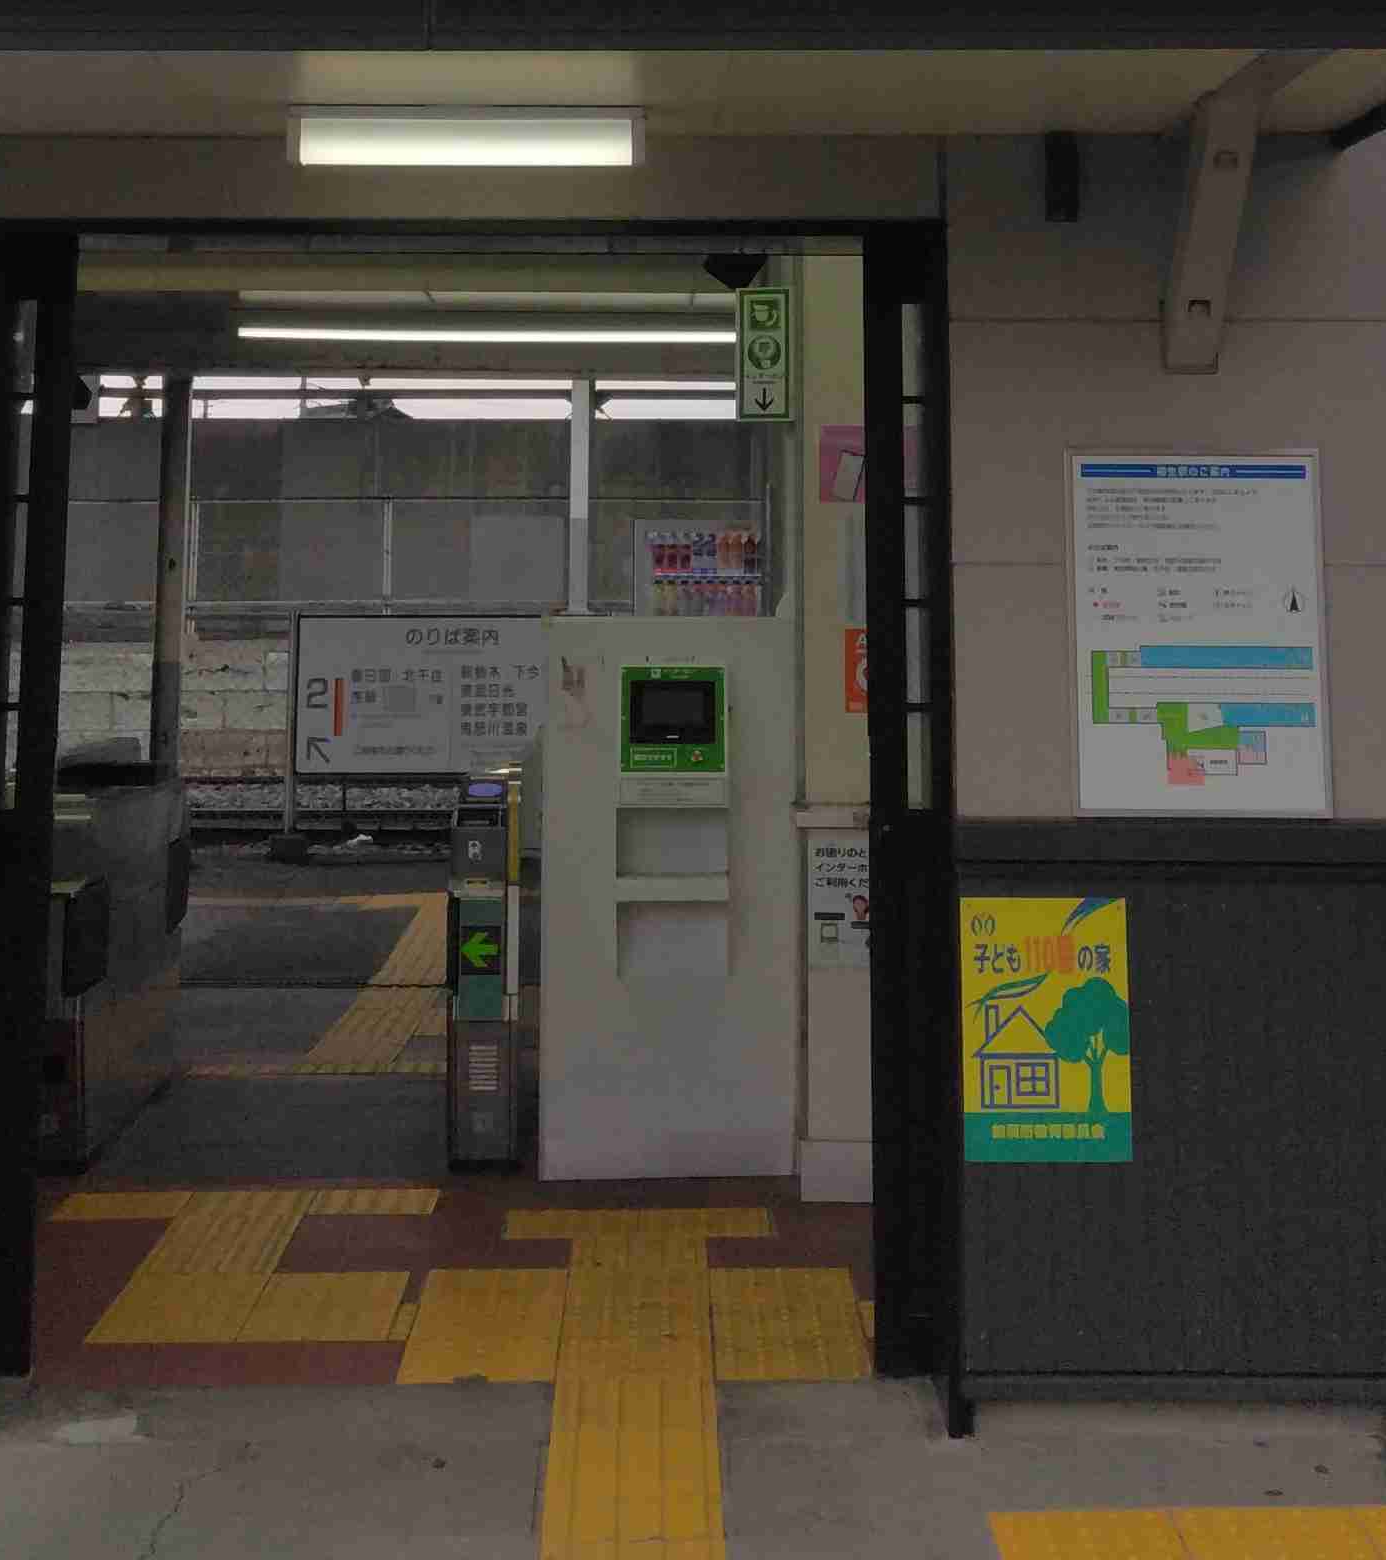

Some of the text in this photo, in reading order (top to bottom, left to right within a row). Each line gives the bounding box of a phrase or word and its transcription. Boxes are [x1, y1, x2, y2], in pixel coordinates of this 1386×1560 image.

[405, 628, 500, 646] のりば案内
[306, 678, 328, 709] 2
